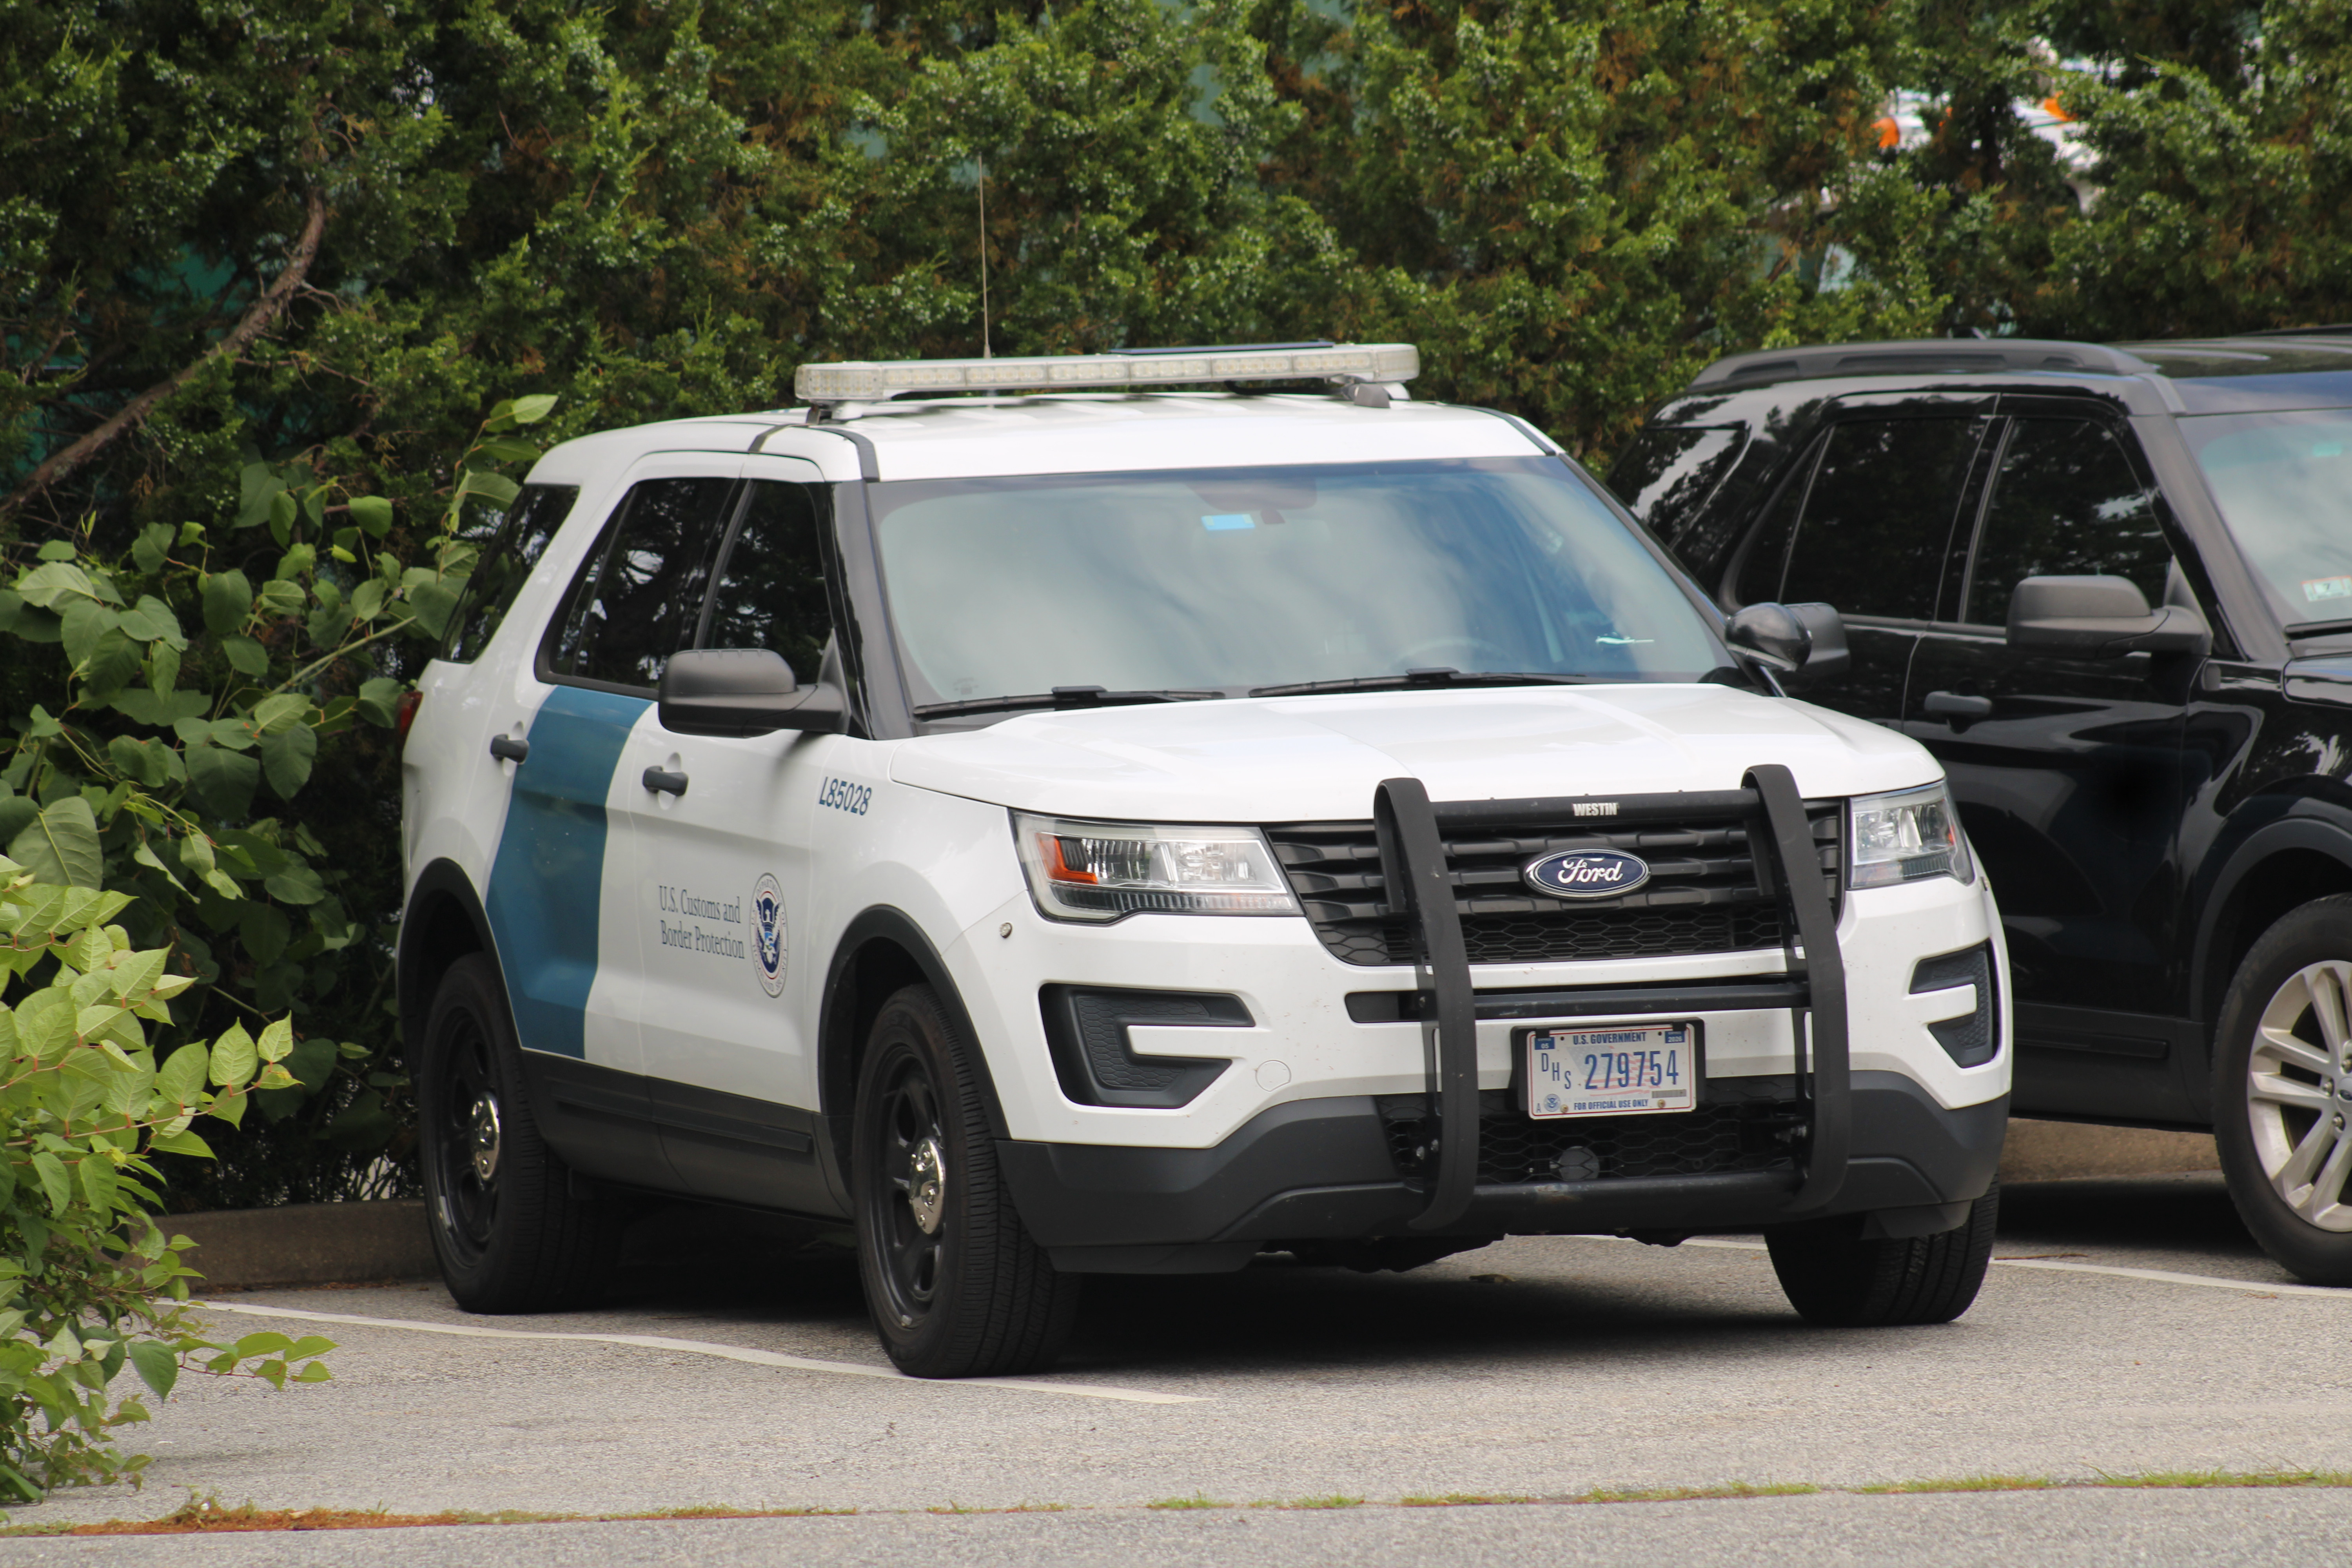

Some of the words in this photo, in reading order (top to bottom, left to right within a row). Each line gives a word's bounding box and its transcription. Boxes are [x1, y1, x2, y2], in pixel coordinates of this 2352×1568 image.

[819, 776, 872, 815] L85028
[1557, 857, 1623, 884] Ford
[659, 885, 678, 913] U.S.
[681, 889, 720, 920] Customs
[724, 896, 741, 923] and
[660, 920, 692, 949] Border
[695, 926, 745, 959] Protection
[1573, 1035, 1588, 1045] U.S.
[1590, 1032, 1646, 1044] GOVERNMENT
[1584, 1050, 1679, 1090] 279754
[1588, 1100, 1617, 1109] OFFICIAL
[1632, 1099, 1649, 1107] ONLY
